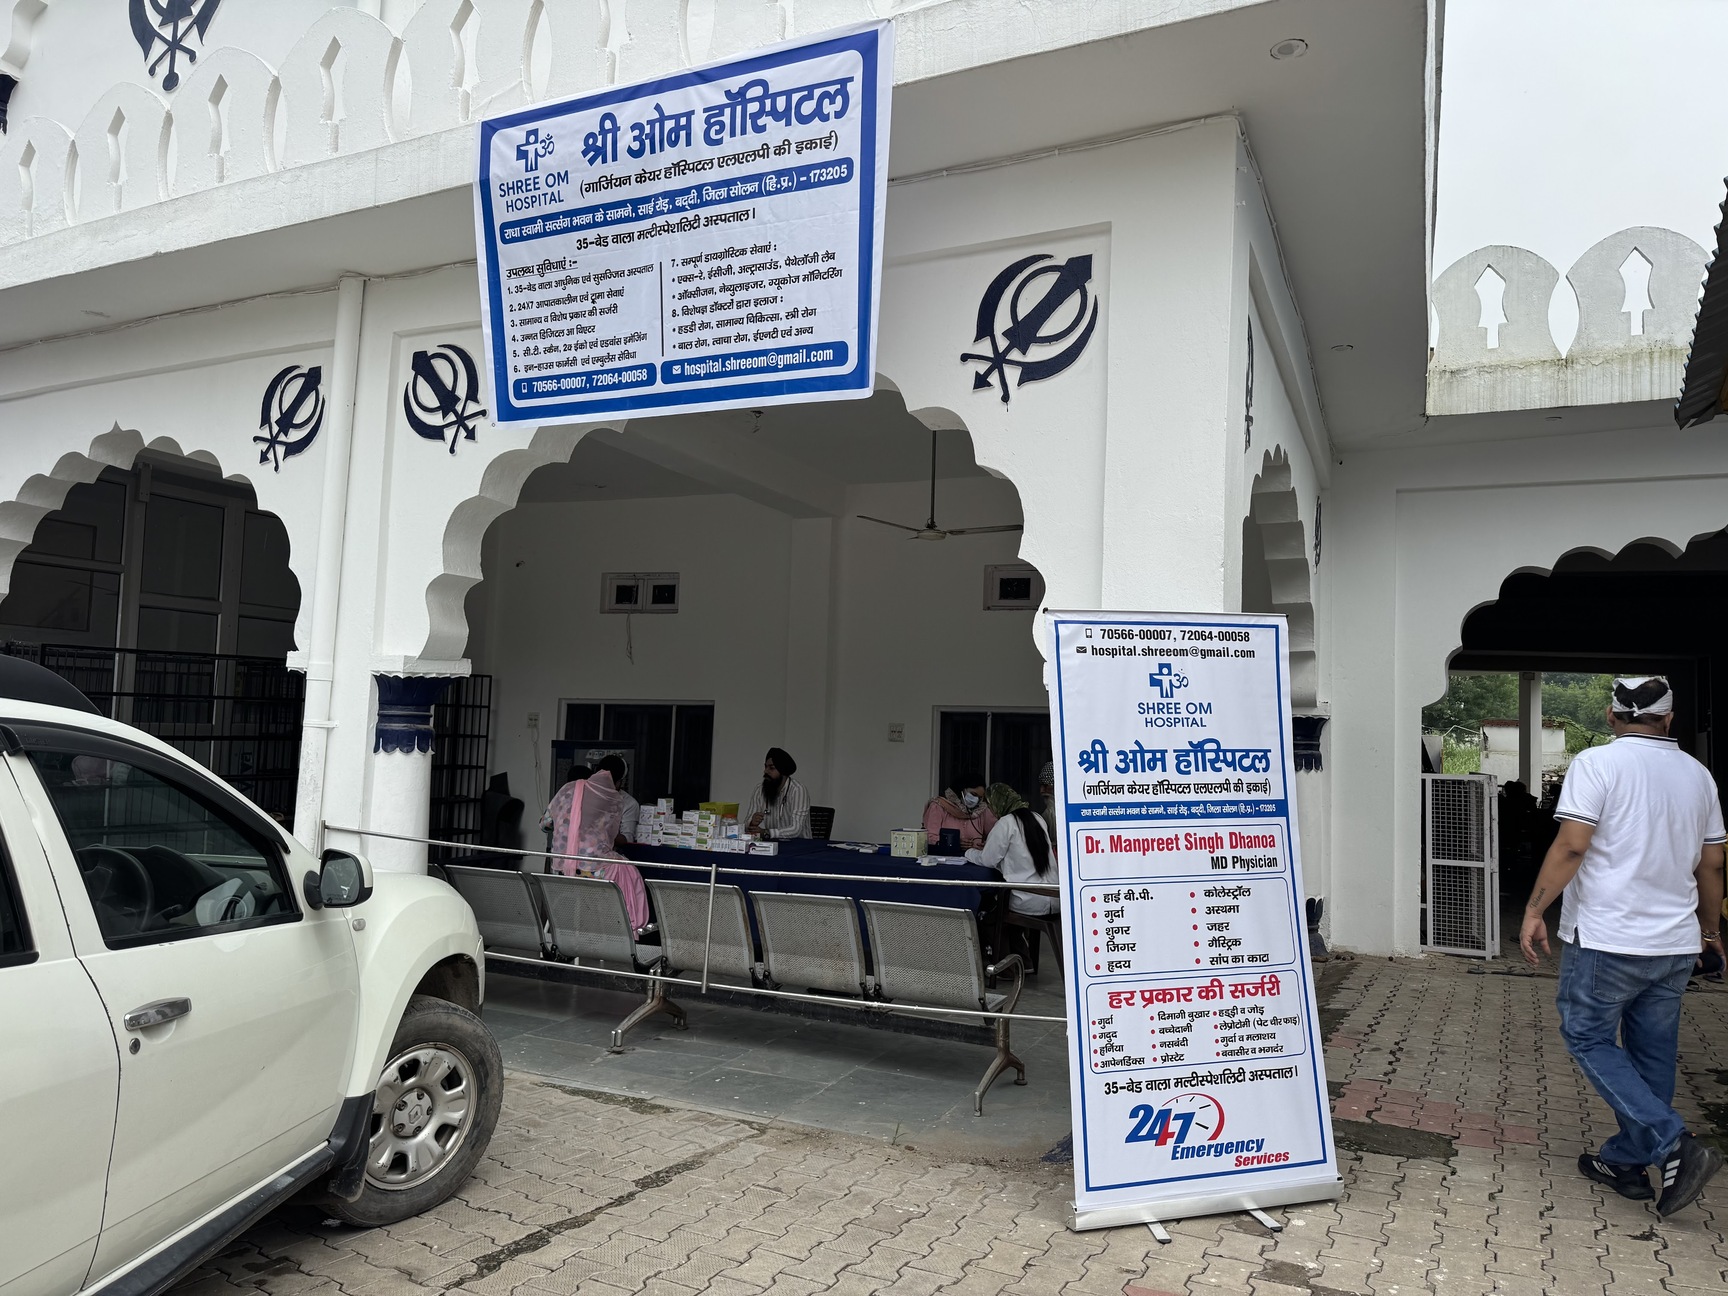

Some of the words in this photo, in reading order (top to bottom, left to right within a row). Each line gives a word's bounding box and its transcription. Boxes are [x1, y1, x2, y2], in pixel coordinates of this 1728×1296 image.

[581, 112, 621, 166] श्री
[627, 102, 695, 159] ओम
[703, 78, 854, 147] हॉस्पिटल
[579, 173, 631, 198] (गार्जियन
[634, 168, 662, 185] केयर
[664, 158, 715, 180] हॉस्पिटल
[717, 143, 770, 169] एलएलपी
[773, 138, 792, 158] की
[795, 130, 839, 154] इकाई)
[499, 176, 541, 198] SHREE
[545, 170, 569, 188] OM
[506, 190, 564, 213] HOSPITAL
[572, 212, 593, 227] भवन
[594, 208, 604, 223] के
[702, 186, 728, 202] जिला
[729, 181, 759, 198] सोलन
[809, 164, 848, 183] 173205
[611, 231, 635, 245] वाला
[636, 214, 701, 240] मल्टीस्पेशलिटी
[536, 256, 567, 278] सुविधाएं
[626, 263, 654, 277] अस्पताल
[670, 258, 679, 268] 7.
[587, 306, 597, 317] की
[671, 308, 680, 318] 8.
[753, 295, 778, 308] इलाज
[801, 306, 817, 318] रोग
[780, 325, 793, 338] एवं
[684, 348, 833, 378] hospital.shreeom@gmail.com
[532, 376, 589, 393] 70566-00007,
[592, 368, 648, 387] 72064-00058
[1100, 628, 1177, 642] 70566-00007,
[1180, 629, 1250, 643] 72064-00058
[1091, 644, 1256, 660] hospital.shreeom@gmail.com
[1137, 702, 1182, 715] SHREE
[1186, 702, 1212, 715] OM
[1145, 716, 1207, 728] HOSPITAL
[1077, 738, 1109, 775] श्री
[1115, 739, 1168, 774] ओम
[1173, 738, 1272, 776] हॉस्पिटल
[1082, 780, 1125, 800] (गार्जियन
[1127, 781, 1150, 796] केयर
[1152, 778, 1192, 796] हॉस्पिटल
[1193, 778, 1232, 795] एलएलपी
[1233, 778, 1244, 794] की
[1085, 835, 1105, 854] Dr.
[1109, 834, 1181, 856] Manpreet
[1184, 832, 1224, 854] Singh
[1229, 831, 1276, 850] Dhanoa
[1210, 856, 1228, 870] MD
[1232, 855, 1278, 872] Physician
[1103, 889, 1121, 903] हाई
[1104, 906, 1125, 923] गुर्दा
[1205, 904, 1240, 915] अस्थमा
[1105, 926, 1131, 940] शुगर
[1206, 921, 1230, 932] जहर
[1106, 940, 1137, 953] जिगर
[1209, 953, 1229, 966] सांप
[1231, 954, 1245, 964] का
[1247, 953, 1269, 963] काटा
[1107, 990, 1136, 1009] हर
[1139, 986, 1193, 1008] प्रकार
[1197, 977, 1225, 1000] की
[1228, 974, 1281, 999] सर्जरी
[1240, 1007, 1246, 1015] व
[1097, 1014, 1113, 1029] गुर्दा
[1145, 1077, 1171, 1092] वाला
[1174, 1067, 1246, 1089] मल्टीस्पेशलिटी
[1171, 1137, 1266, 1161] Emergency
[1234, 1151, 1290, 1168] Services
